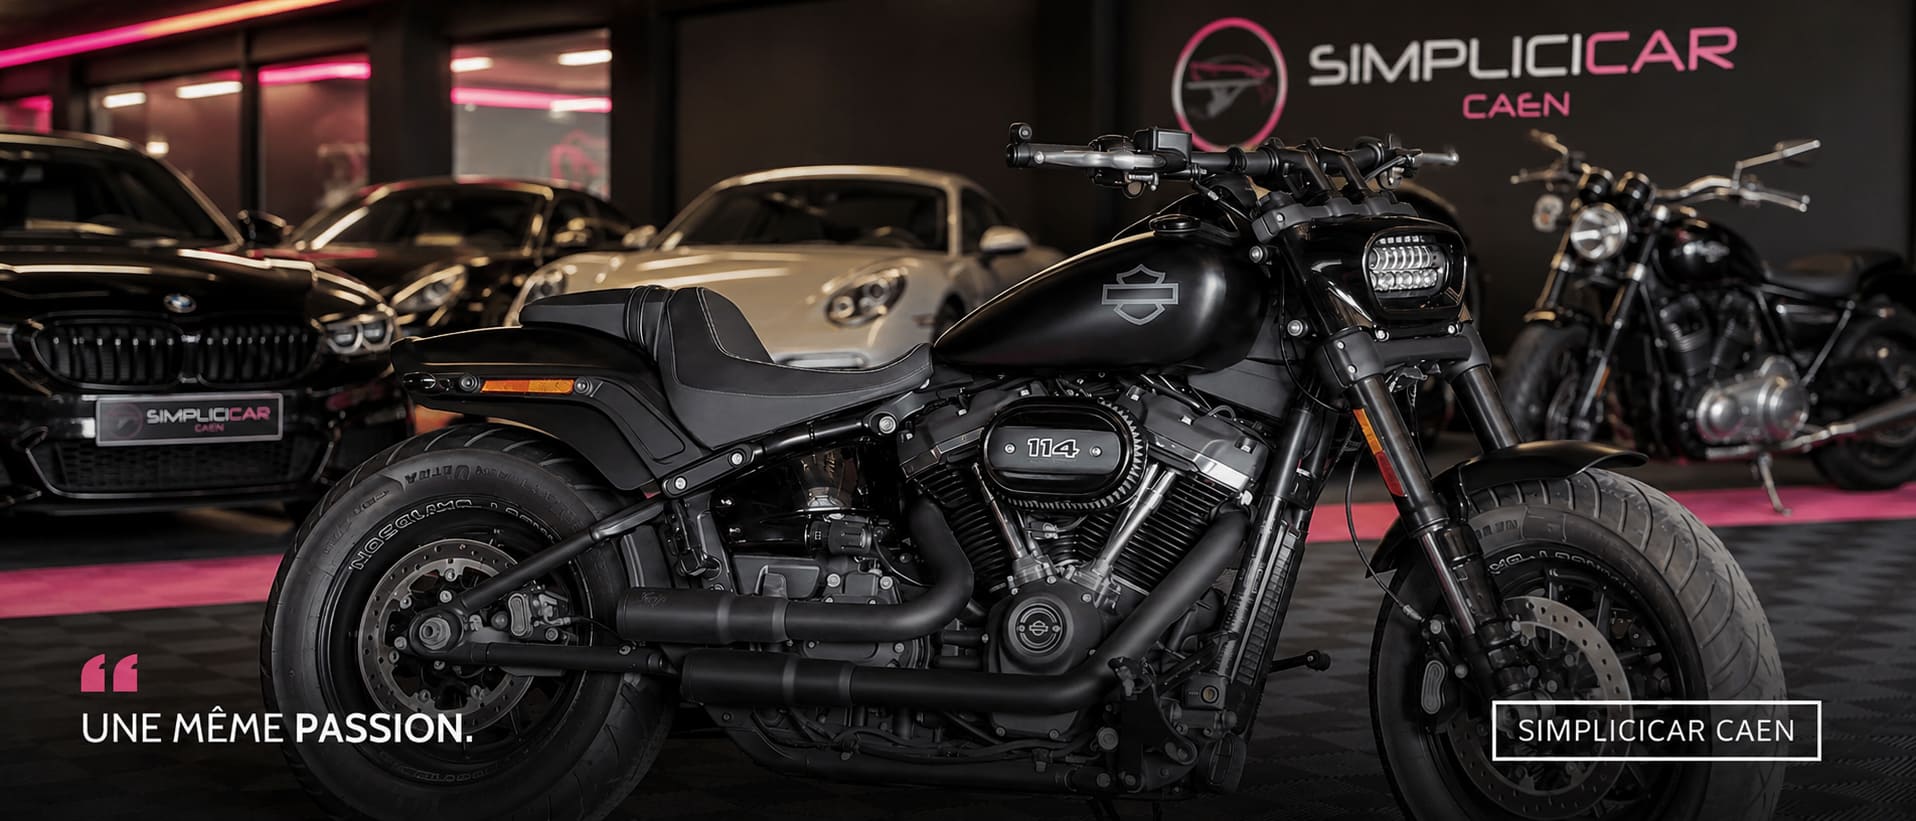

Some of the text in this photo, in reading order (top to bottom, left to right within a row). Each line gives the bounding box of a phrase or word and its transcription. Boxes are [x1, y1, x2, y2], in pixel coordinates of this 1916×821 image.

[1309, 26, 1738, 86] SIMPLICICAR
[1462, 91, 1570, 119] CAEN
[146, 406, 271, 424] SIMPLICICAR
[194, 423, 225, 433] CAEN
[1027, 438, 1080, 458] 114
